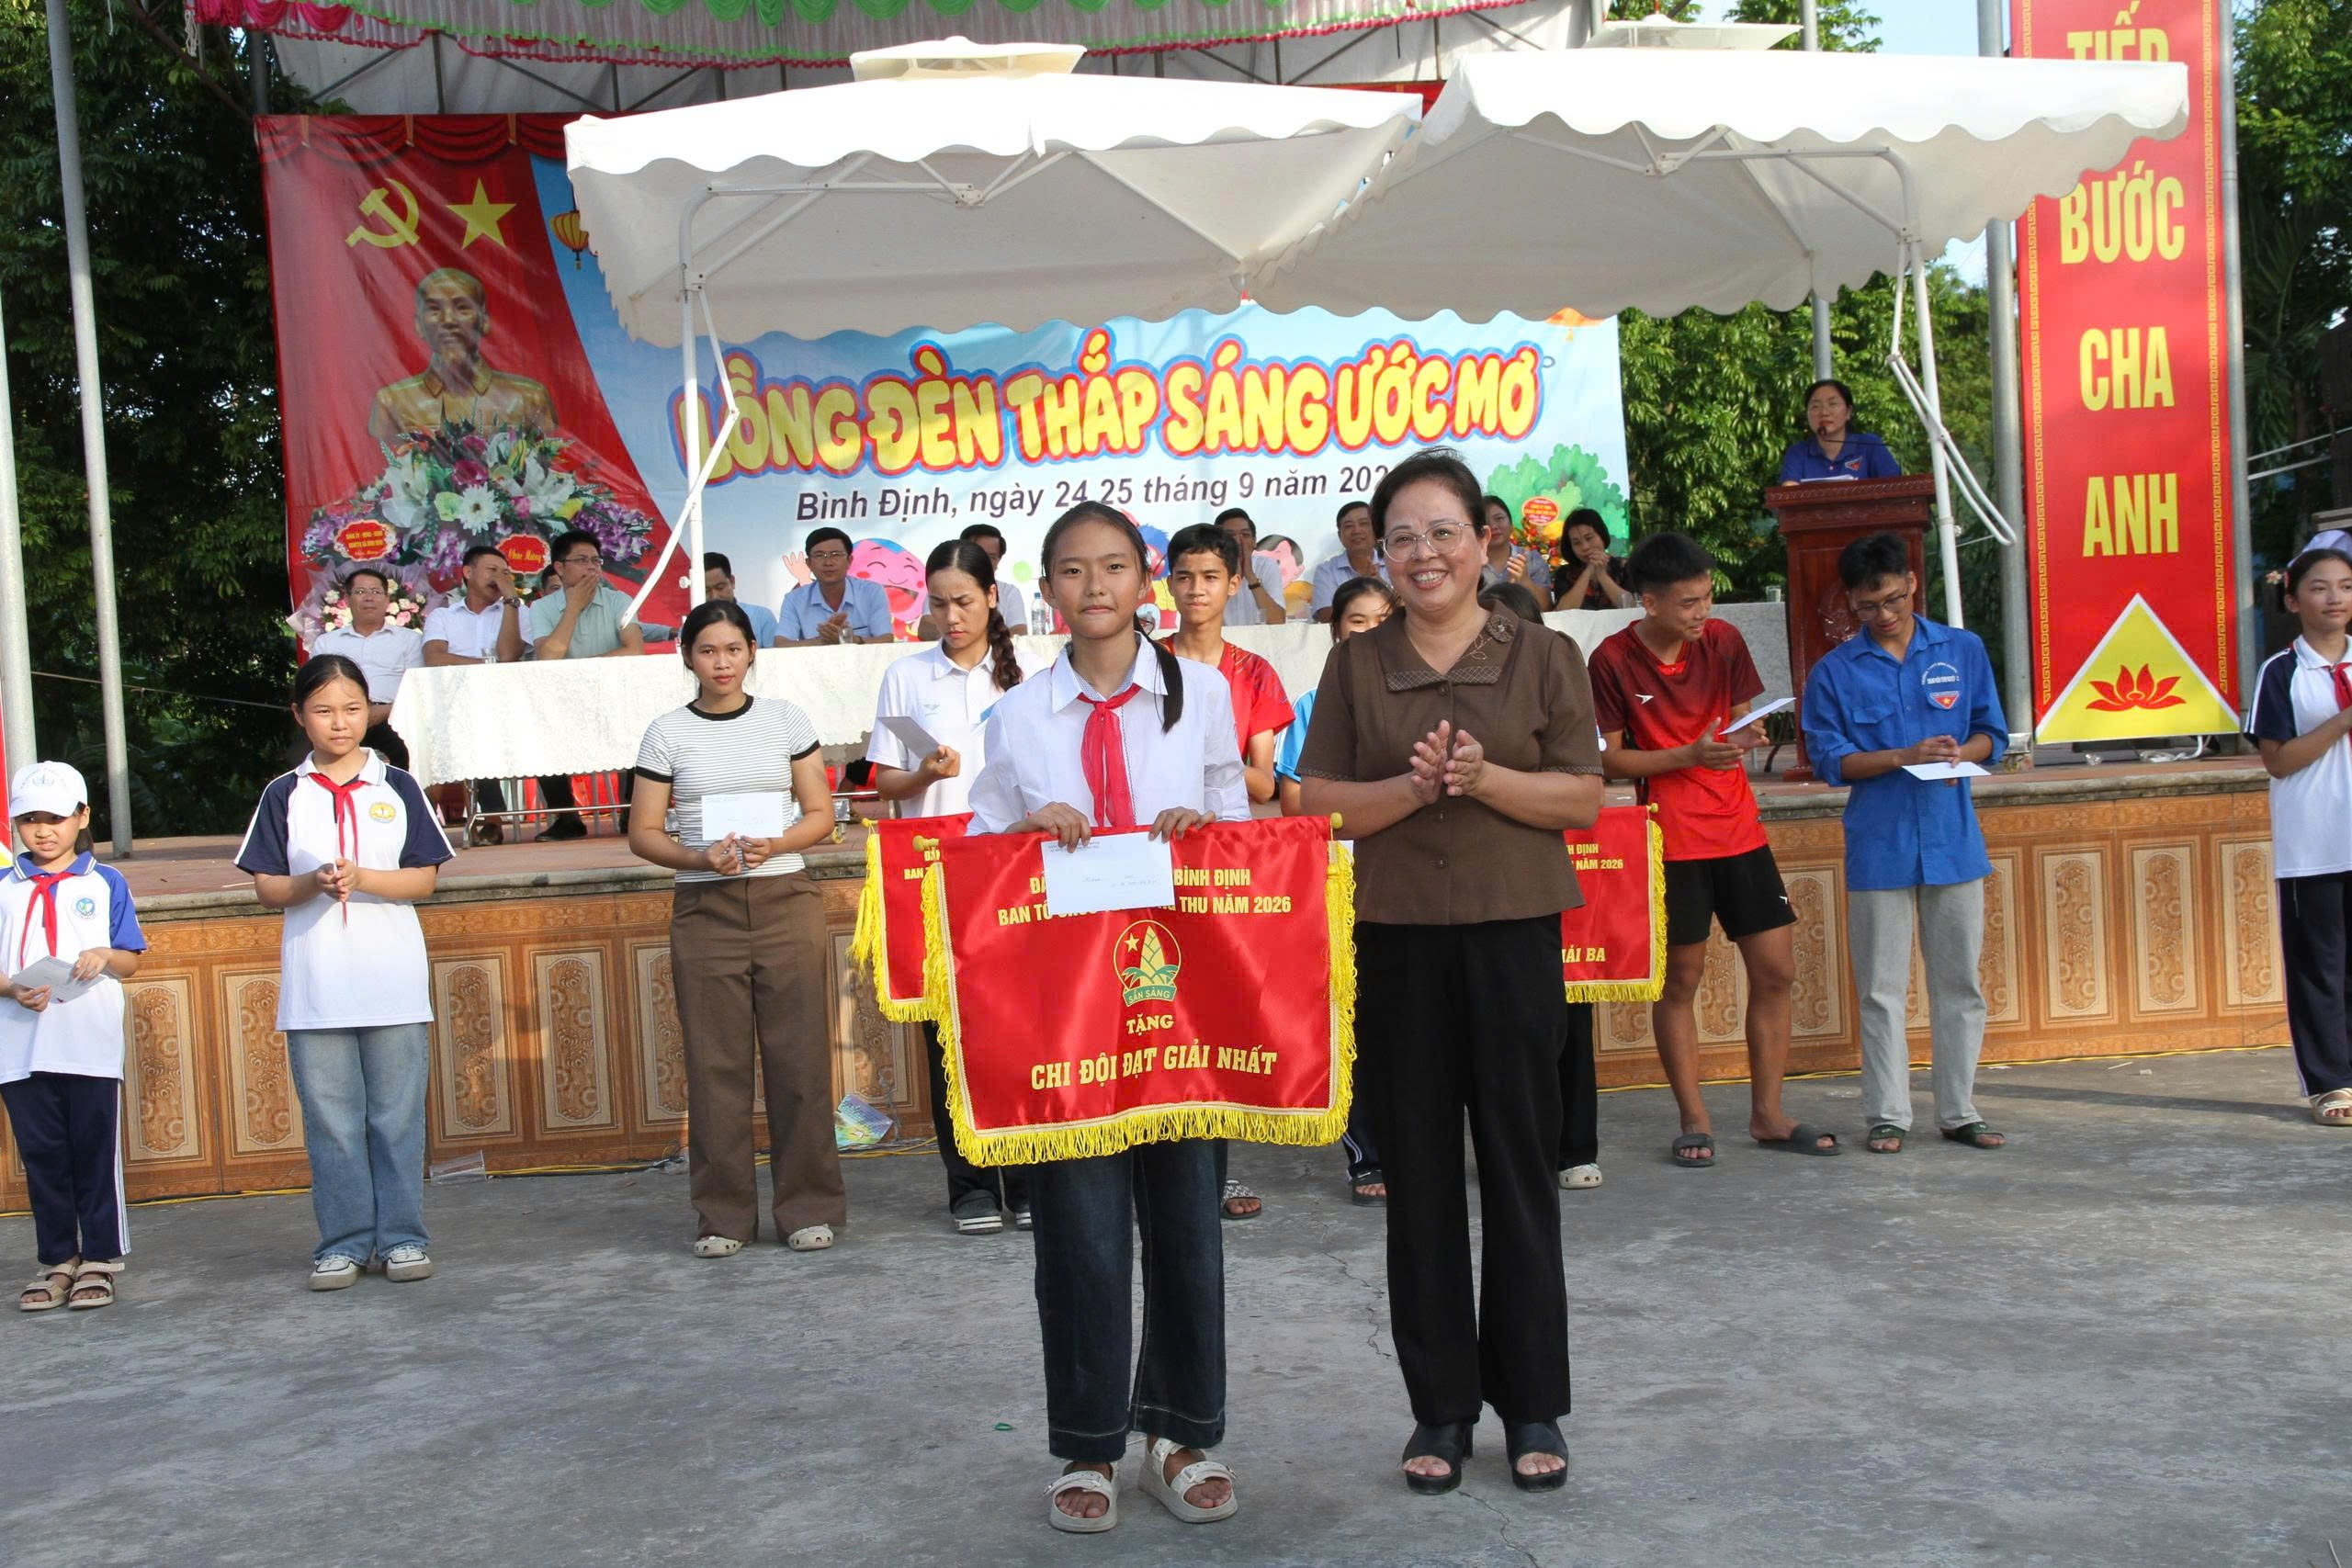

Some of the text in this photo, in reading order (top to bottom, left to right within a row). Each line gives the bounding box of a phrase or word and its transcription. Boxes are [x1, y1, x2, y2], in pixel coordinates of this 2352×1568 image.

[2060, 160, 2185, 264] BƯỚC
[2079, 326, 2175, 412] CHA
[673, 330, 1541, 483] LỒNG ĐÈN THẮP SÁNG ƯỚC MƠ
[797, 465, 1389, 523] Bình Định, ngày 24 25 tháng 9 năm 202
[2083, 472, 2179, 557] ANH
[1576, 843, 1599, 856] ĐỊNH
[1576, 858, 1599, 871] NĂM
[1600, 859, 1623, 869] 2026
[903, 867, 924, 880] BAN
[1173, 865, 1210, 886] BÌNH
[1214, 868, 1250, 889] ĐỊNH
[998, 905, 1031, 926] BAN
[1179, 896, 1208, 914] THU
[1212, 893, 1250, 914] NĂM
[1253, 896, 1292, 913] 2026
[1585, 947, 1606, 963] BA
[1125, 1013, 1174, 1036] TẶNG
[1031, 1038, 1278, 1090] CHI ĐỘI ĐẠT GIẢI NHẤT
